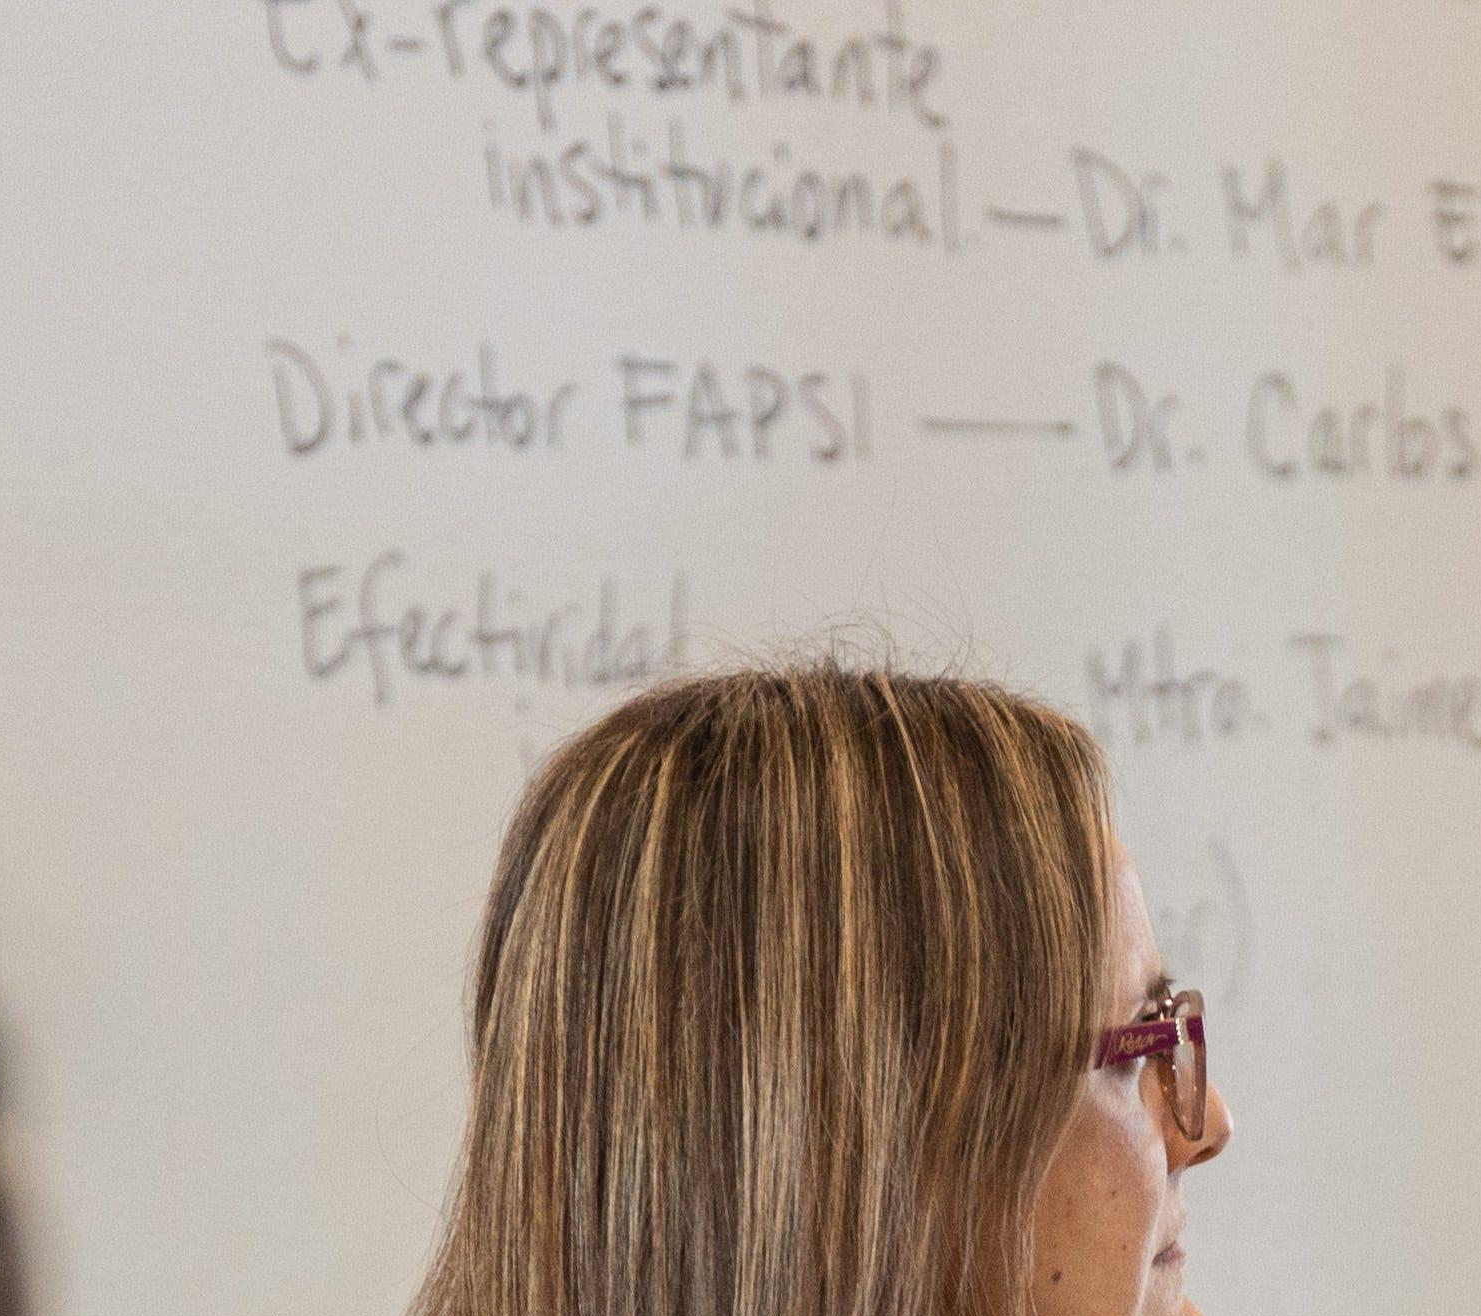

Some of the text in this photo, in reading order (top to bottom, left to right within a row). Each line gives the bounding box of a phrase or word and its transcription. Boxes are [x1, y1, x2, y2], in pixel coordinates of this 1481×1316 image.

[1071, 145, 1187, 258] Dr.
[1221, 156, 1387, 273] Mar
[265, 334, 577, 458] Director
[619, 350, 871, 464] FAPSI
[1091, 360, 1209, 477] Dr.
[1244, 360, 1479, 482] Carlos
